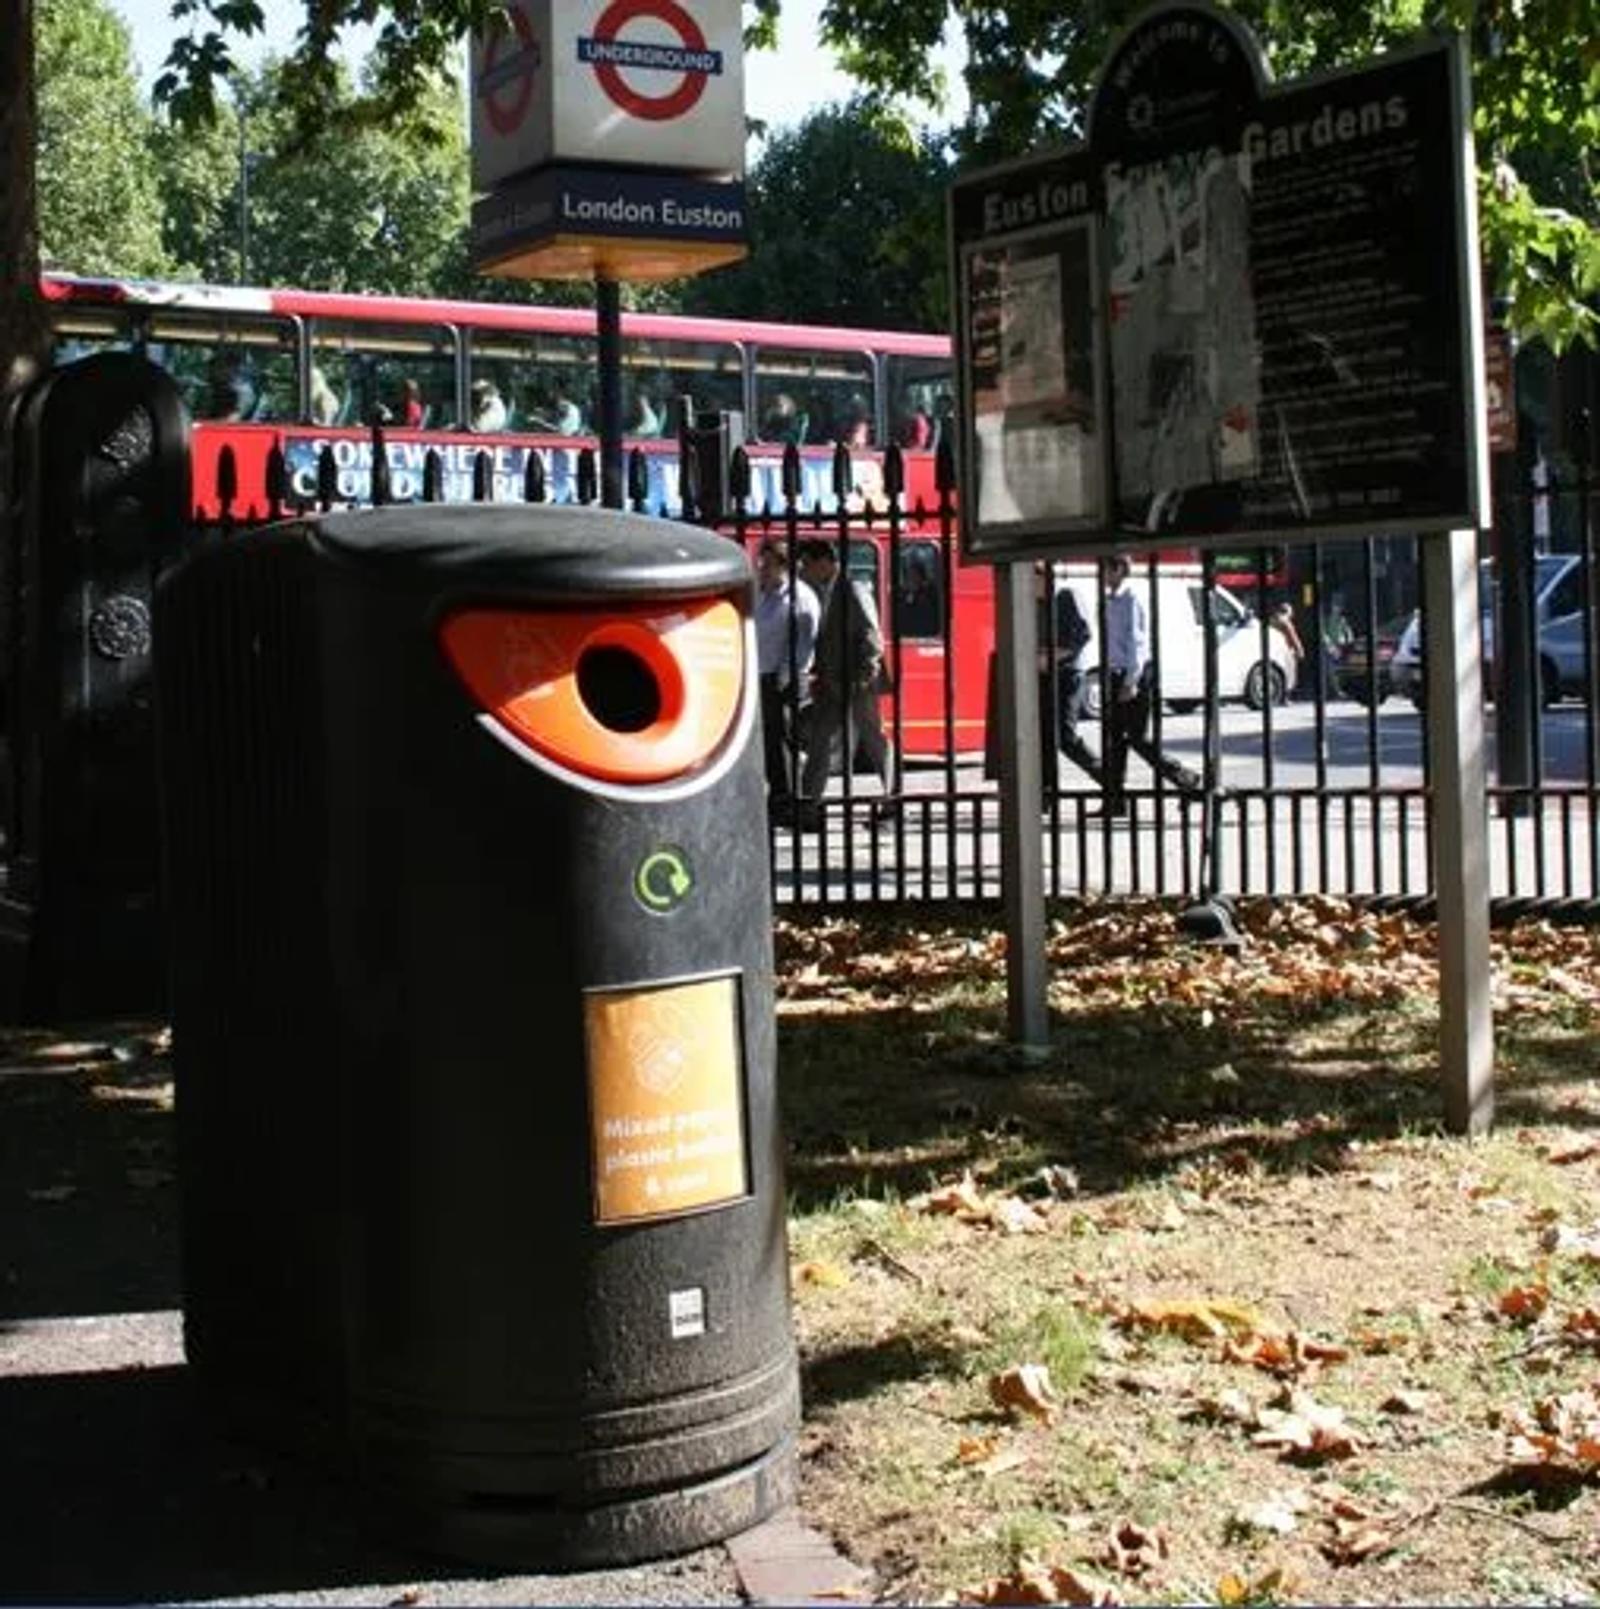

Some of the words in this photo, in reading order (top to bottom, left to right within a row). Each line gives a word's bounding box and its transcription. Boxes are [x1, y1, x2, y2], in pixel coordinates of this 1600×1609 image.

[586, 44, 715, 68] UNDERGROUND
[984, 178, 1089, 233] Euston
[1243, 96, 1407, 162] Gardens
[563, 193, 654, 223] London
[661, 200, 742, 229] Euston
